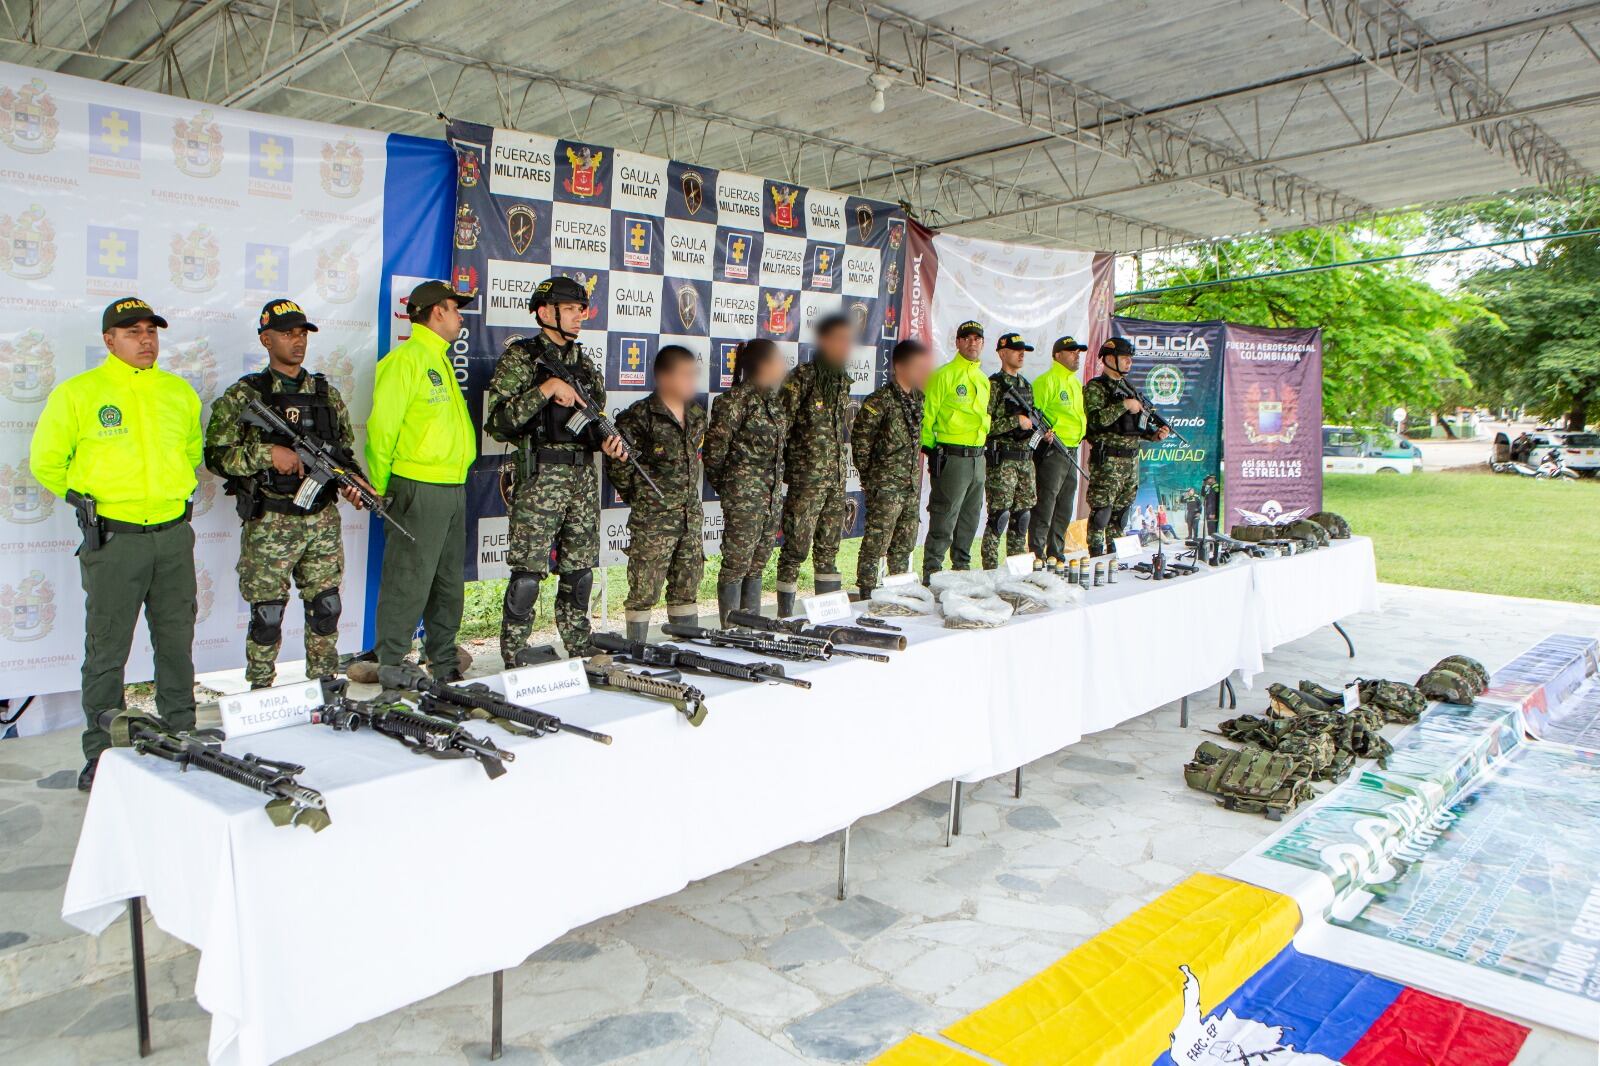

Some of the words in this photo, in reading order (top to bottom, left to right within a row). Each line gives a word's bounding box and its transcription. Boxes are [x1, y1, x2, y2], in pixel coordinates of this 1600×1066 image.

[495, 146, 551, 166] FUERZAS
[0, 168, 25, 179] CITO
[494, 163, 551, 183] MILITARES
[620, 166, 661, 186] GAULA
[621, 182, 658, 200] MILITAR
[718, 186, 760, 203] FUERZAS
[718, 200, 760, 217] MILITARES
[810, 203, 840, 218] GAULA
[555, 219, 607, 237] FUERZAS
[811, 216, 841, 230] MILITAR
[554, 236, 607, 253] MILITARES
[670, 235, 707, 251] GAULA
[671, 250, 706, 265] MILITAR
[764, 247, 802, 263] FUERZAS
[762, 261, 801, 276] MILITARES
[847, 259, 875, 273] GAULA
[492, 278, 537, 293] FUERZA
[848, 271, 874, 285] MILITAR
[490, 295, 531, 310] MILITAR
[616, 288, 654, 303] GAULA
[910, 252, 924, 339] NACIONAL
[616, 304, 653, 317] MILITAR
[714, 297, 755, 311] FUERZAS
[712, 312, 755, 325] MILITARES
[1225, 341, 1256, 350] FUERZA
[1257, 343, 1316, 353] AEROESPACIAL
[1240, 351, 1302, 362] COLOMBIANA
[0, 420, 24, 429] CITO
[1139, 449, 1205, 462] MUNIDAD
[1256, 460, 1266, 468] SE
[1267, 460, 1278, 468] VA
[1279, 460, 1285, 468] A
[1287, 460, 1302, 468] LAS
[1242, 468, 1302, 478] ESTRELLAS
[704, 530, 723, 541] MILIT
[0, 542, 25, 550] CITO
[27, 539, 78, 549] NACIONAL
[481, 551, 509, 564] MILIT
[0, 658, 25, 668] CITO
[27, 653, 78, 665] NACIONAL
[516, 685, 547, 699] ARMAS
[548, 678, 581, 692] LARGAS
[259, 695, 289, 709] MIRA
[240, 704, 311, 726] TELESCÓPICA
